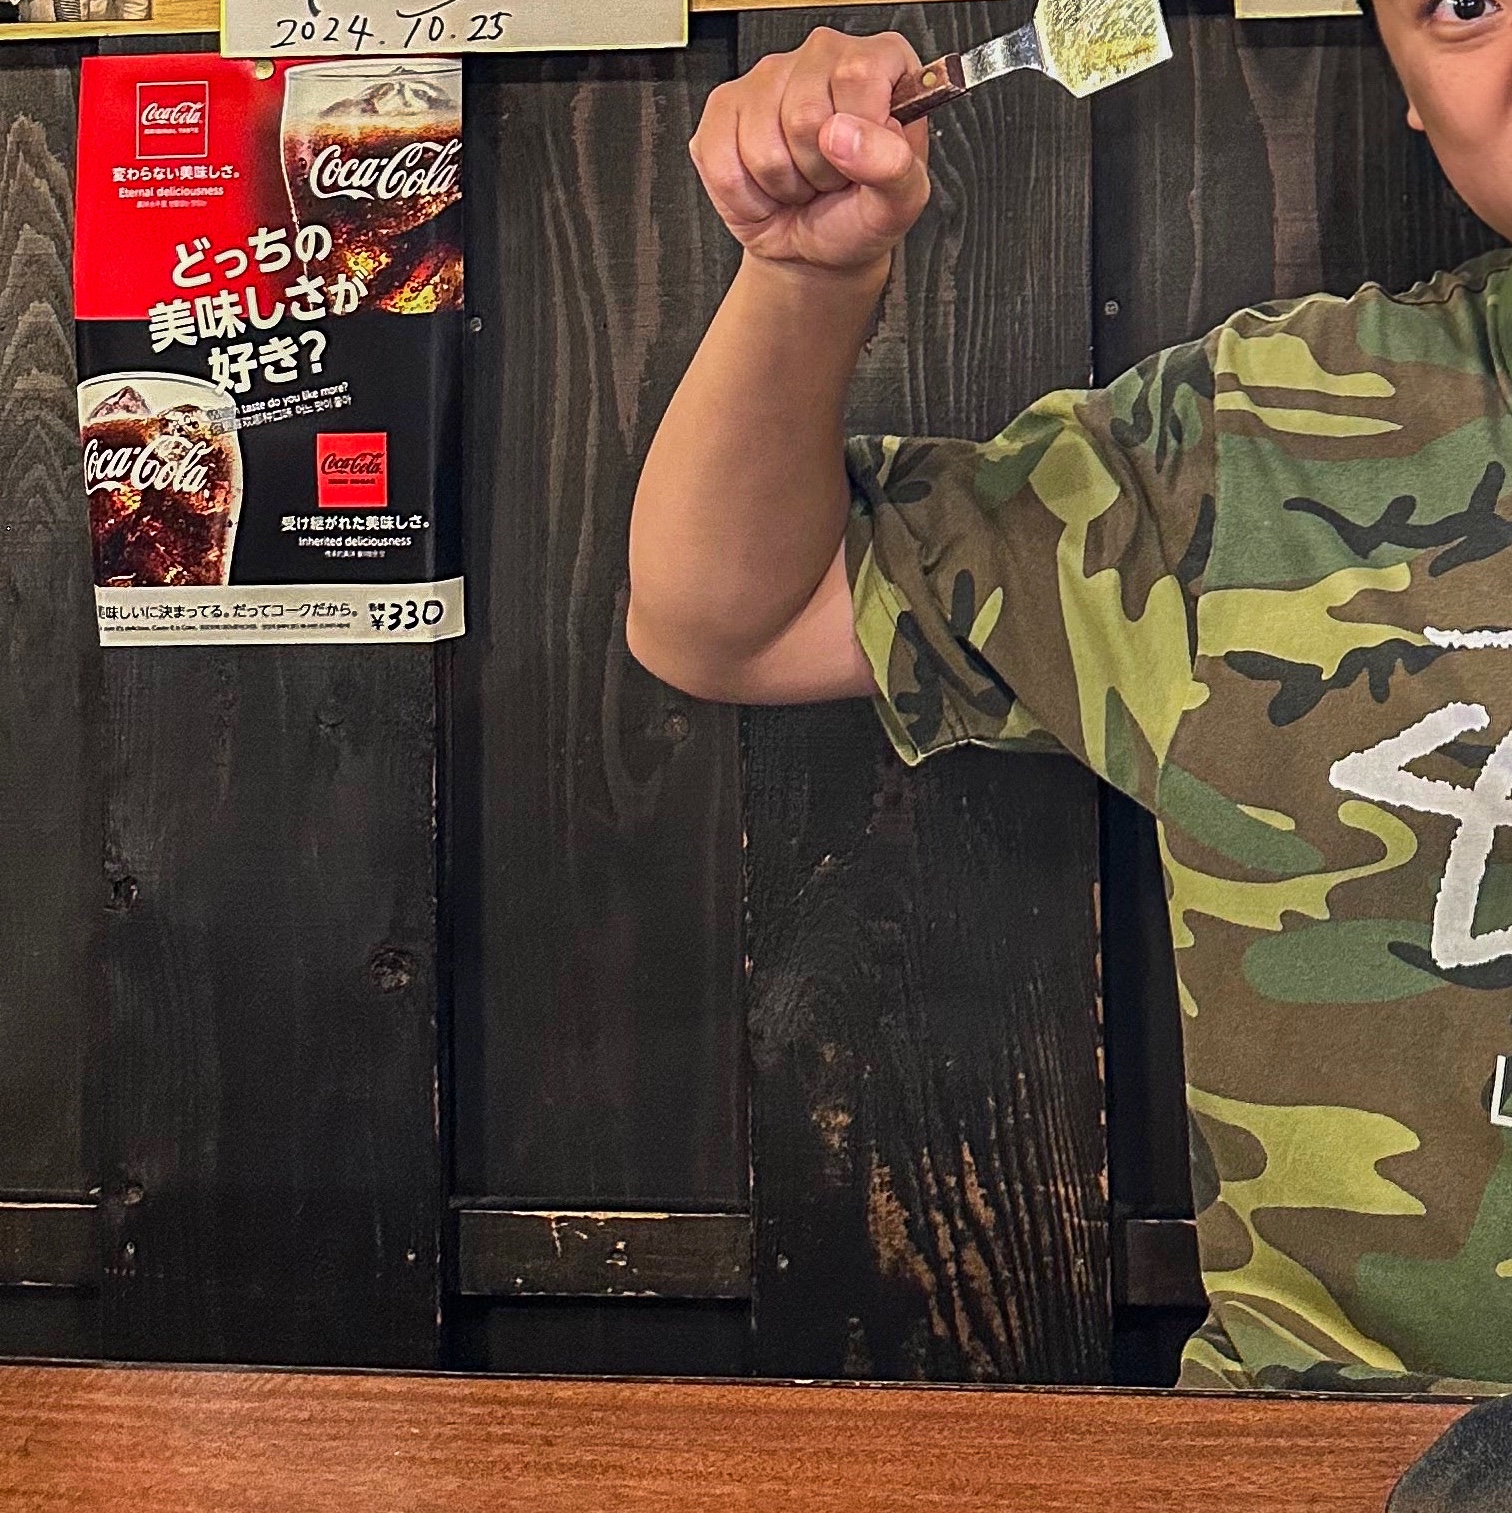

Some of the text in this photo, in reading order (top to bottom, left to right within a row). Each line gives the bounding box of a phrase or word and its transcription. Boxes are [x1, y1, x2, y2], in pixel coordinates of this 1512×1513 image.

[118, 186, 224, 198] Eternal deliciousness
[309, 138, 462, 201] Coca-Cola
[171, 224, 332, 288] どっちの
[148, 267, 369, 353] 美味しさが
[299, 535, 412, 547] Inherited deliciousness
